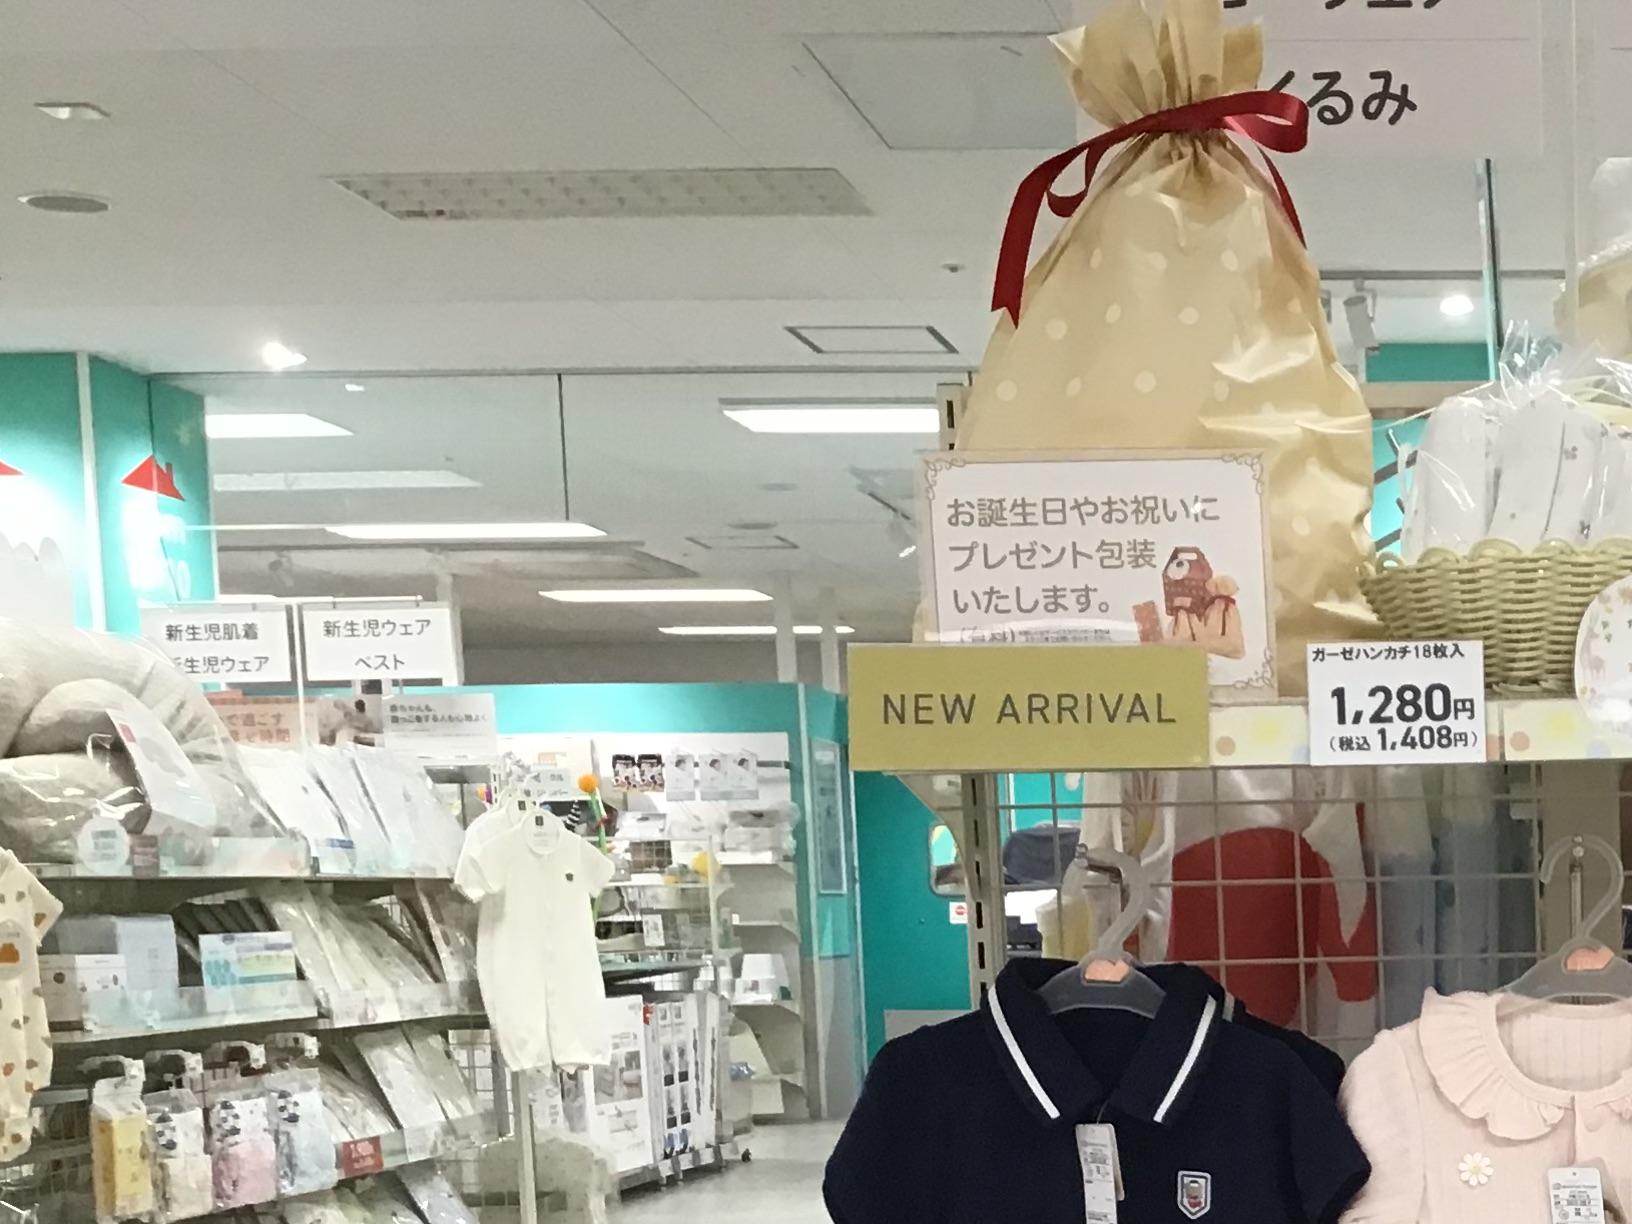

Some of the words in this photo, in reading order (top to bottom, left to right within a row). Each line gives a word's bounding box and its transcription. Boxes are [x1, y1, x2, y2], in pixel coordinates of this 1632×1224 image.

[947, 495, 1221, 527] お誕生日やお祝いに
[949, 539, 1157, 571] プレゼント包装
[953, 584, 1110, 615] いたします。
[165, 622, 259, 641] 新生児肌着
[323, 619, 431, 639] 新生児ウェア
[354, 654, 405, 672] ベスト
[1312, 643, 1465, 662] ガーゼハンカチ18枚入
[882, 693, 976, 725] NEW
[996, 692, 1177, 724] ARRIVAL
[1331, 683, 1475, 725] 1,280円
